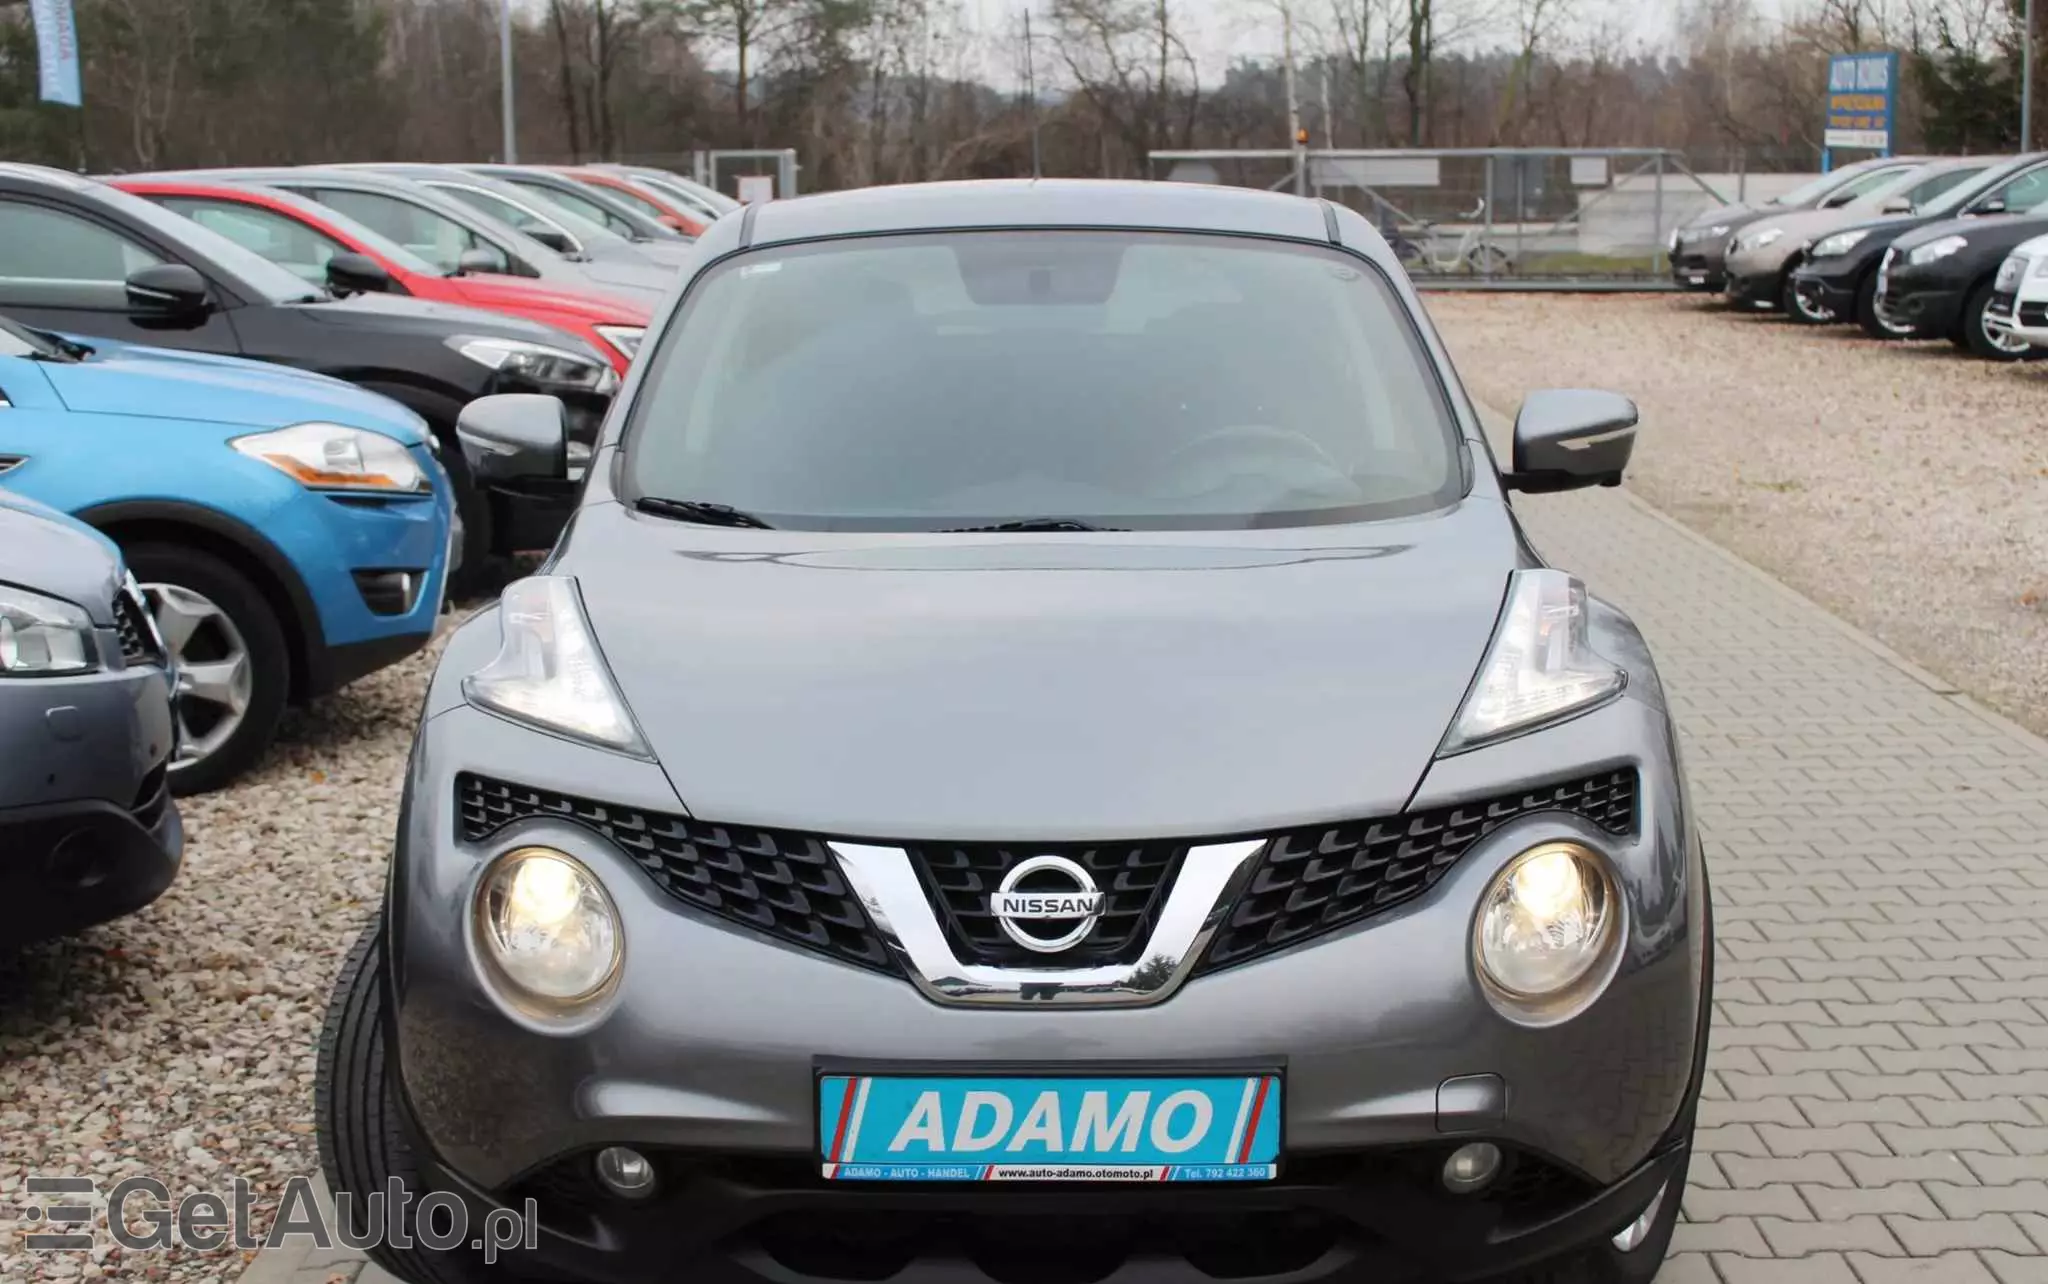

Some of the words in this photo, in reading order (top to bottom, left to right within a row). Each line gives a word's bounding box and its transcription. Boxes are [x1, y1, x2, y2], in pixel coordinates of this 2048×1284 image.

[1003, 898, 1094, 913] NISSAN
[888, 1089, 1214, 1153] ADAMO
[844, 1167, 881, 1178] ADAMO
[890, 1167, 919, 1178] AUTO
[927, 1167, 970, 1178] HANDEL
[998, 1168, 1153, 1179] www.auto-adamo.otomoto.pl
[1184, 1168, 1202, 1178] Tel.
[1205, 1168, 1224, 1178] 792
[1226, 1168, 1244, 1177] 422
